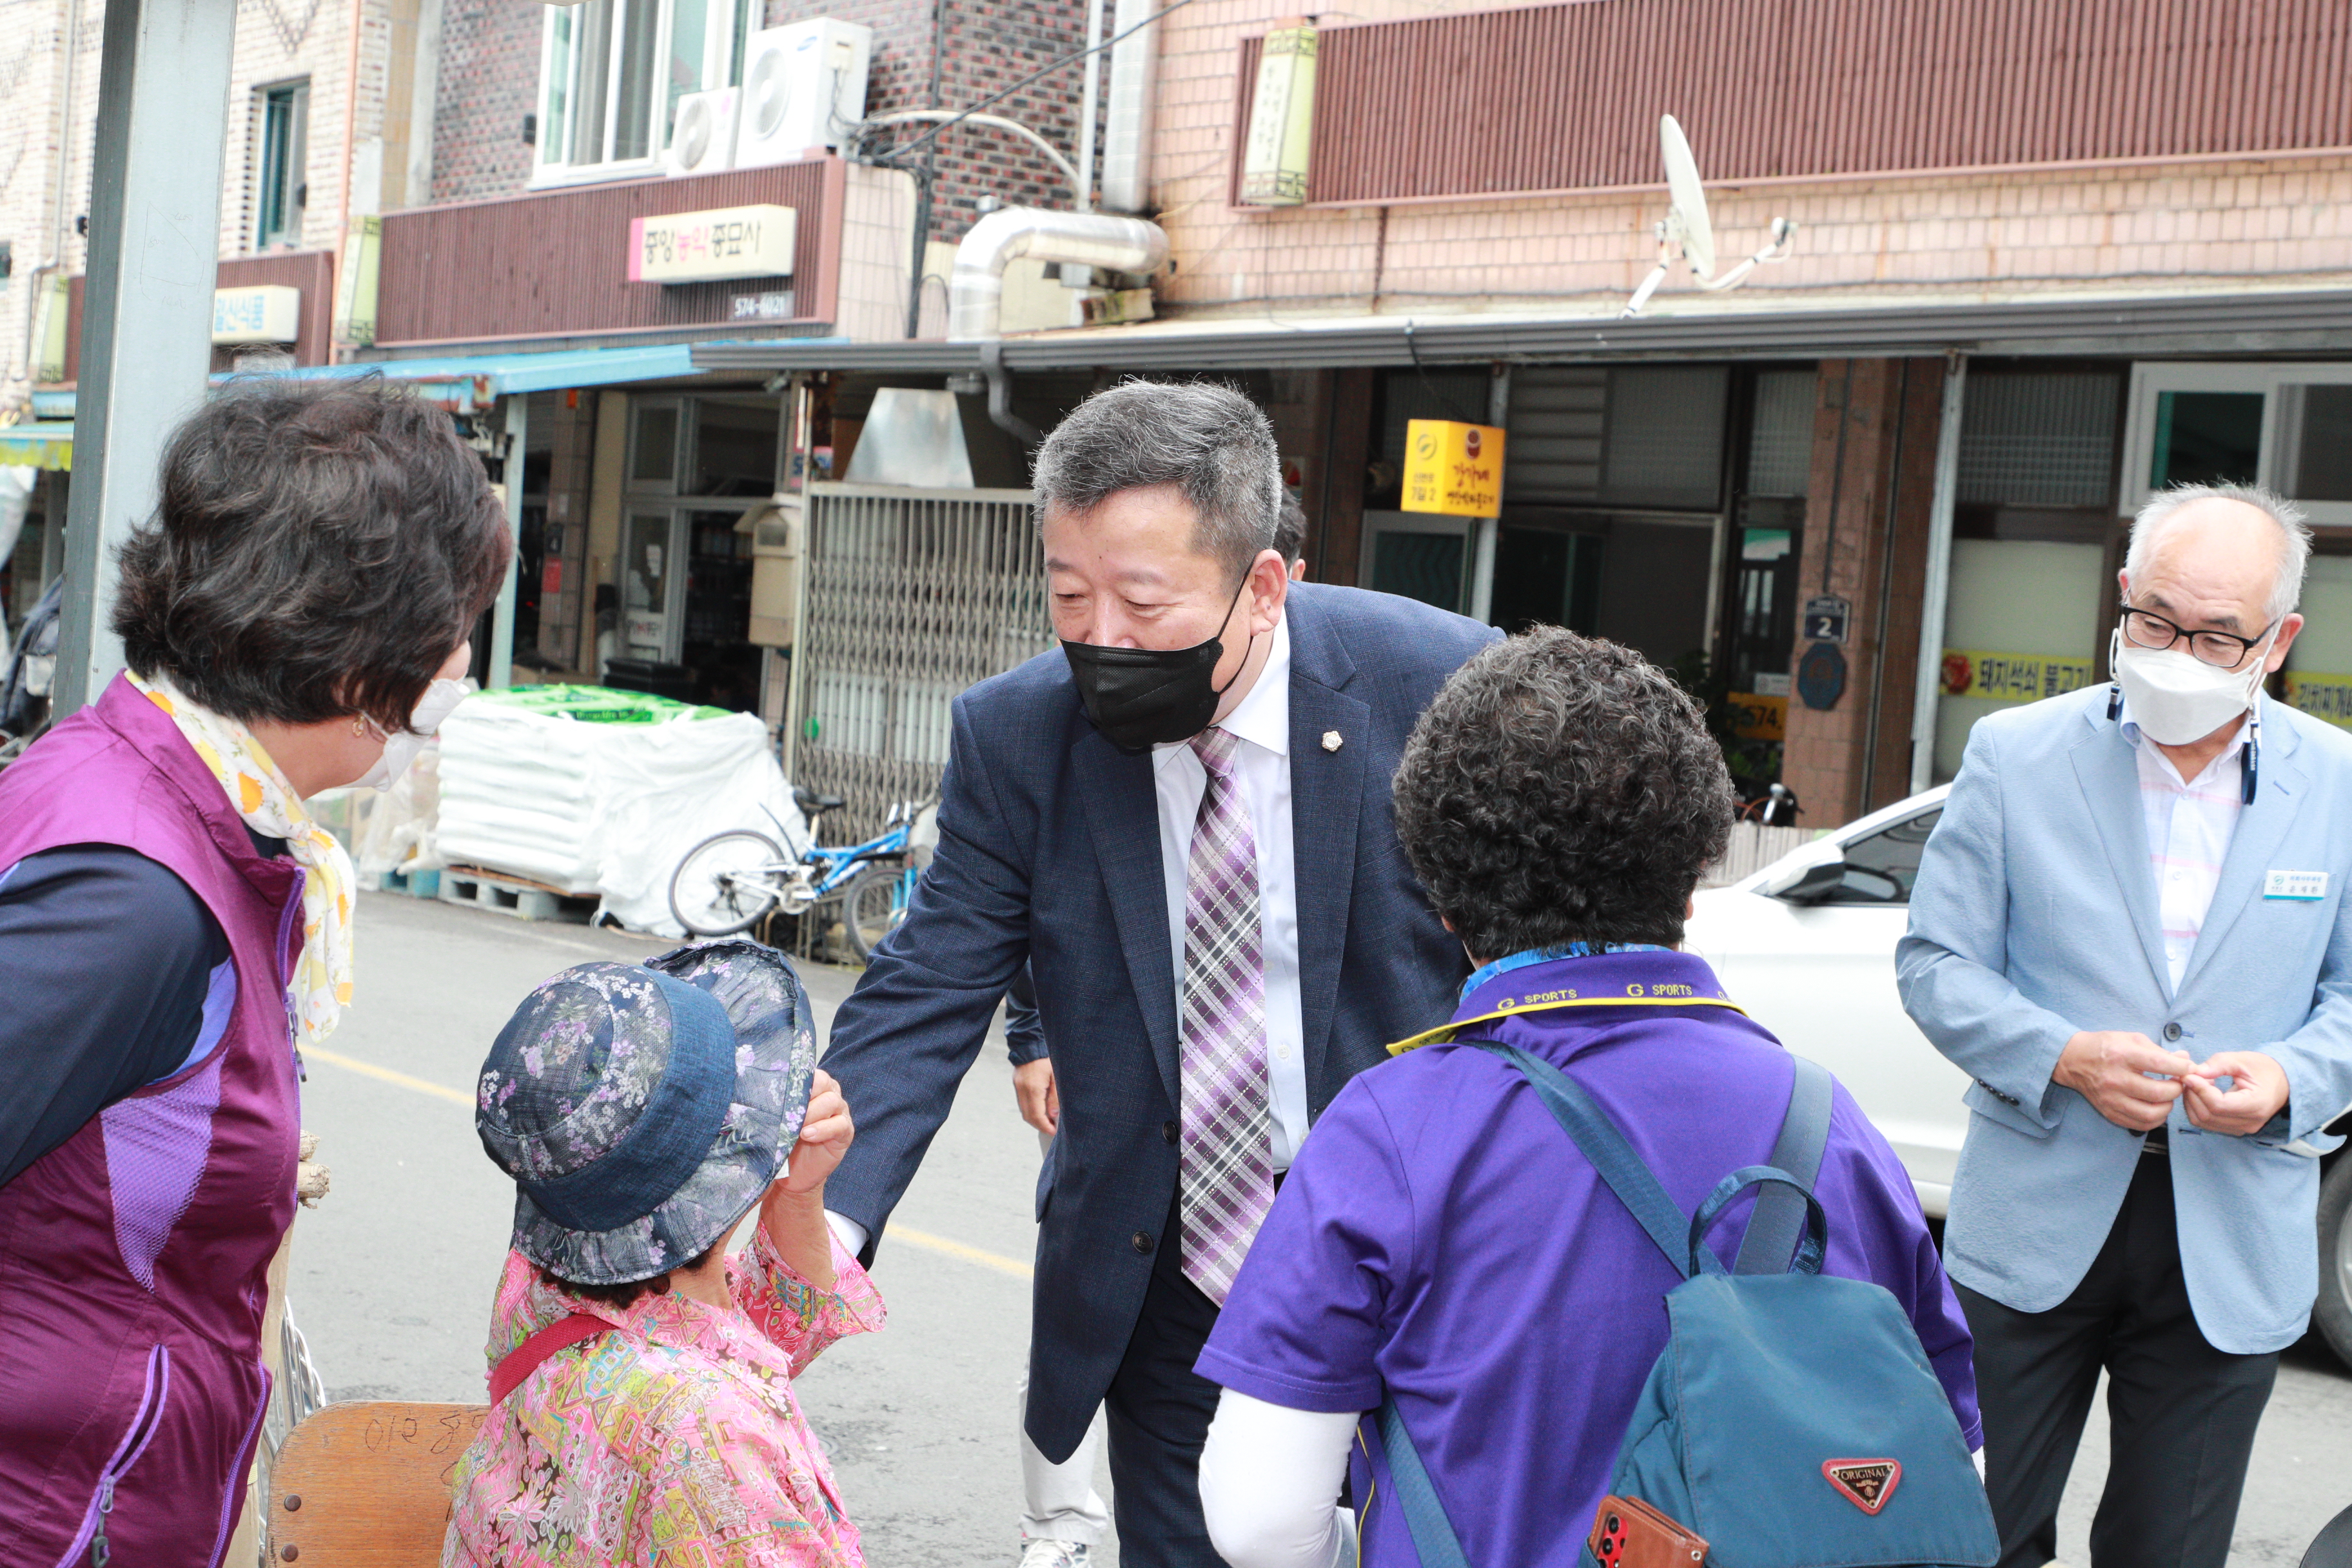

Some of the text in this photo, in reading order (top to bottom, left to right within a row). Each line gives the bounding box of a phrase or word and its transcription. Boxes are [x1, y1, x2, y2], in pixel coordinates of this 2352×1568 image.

[1817, 617, 1832, 638] 2
[1627, 983, 1693, 997] G SPORTS
[1497, 988, 1578, 1011] G SPORTS
[1841, 1468, 1888, 1480] ORIGINAL
